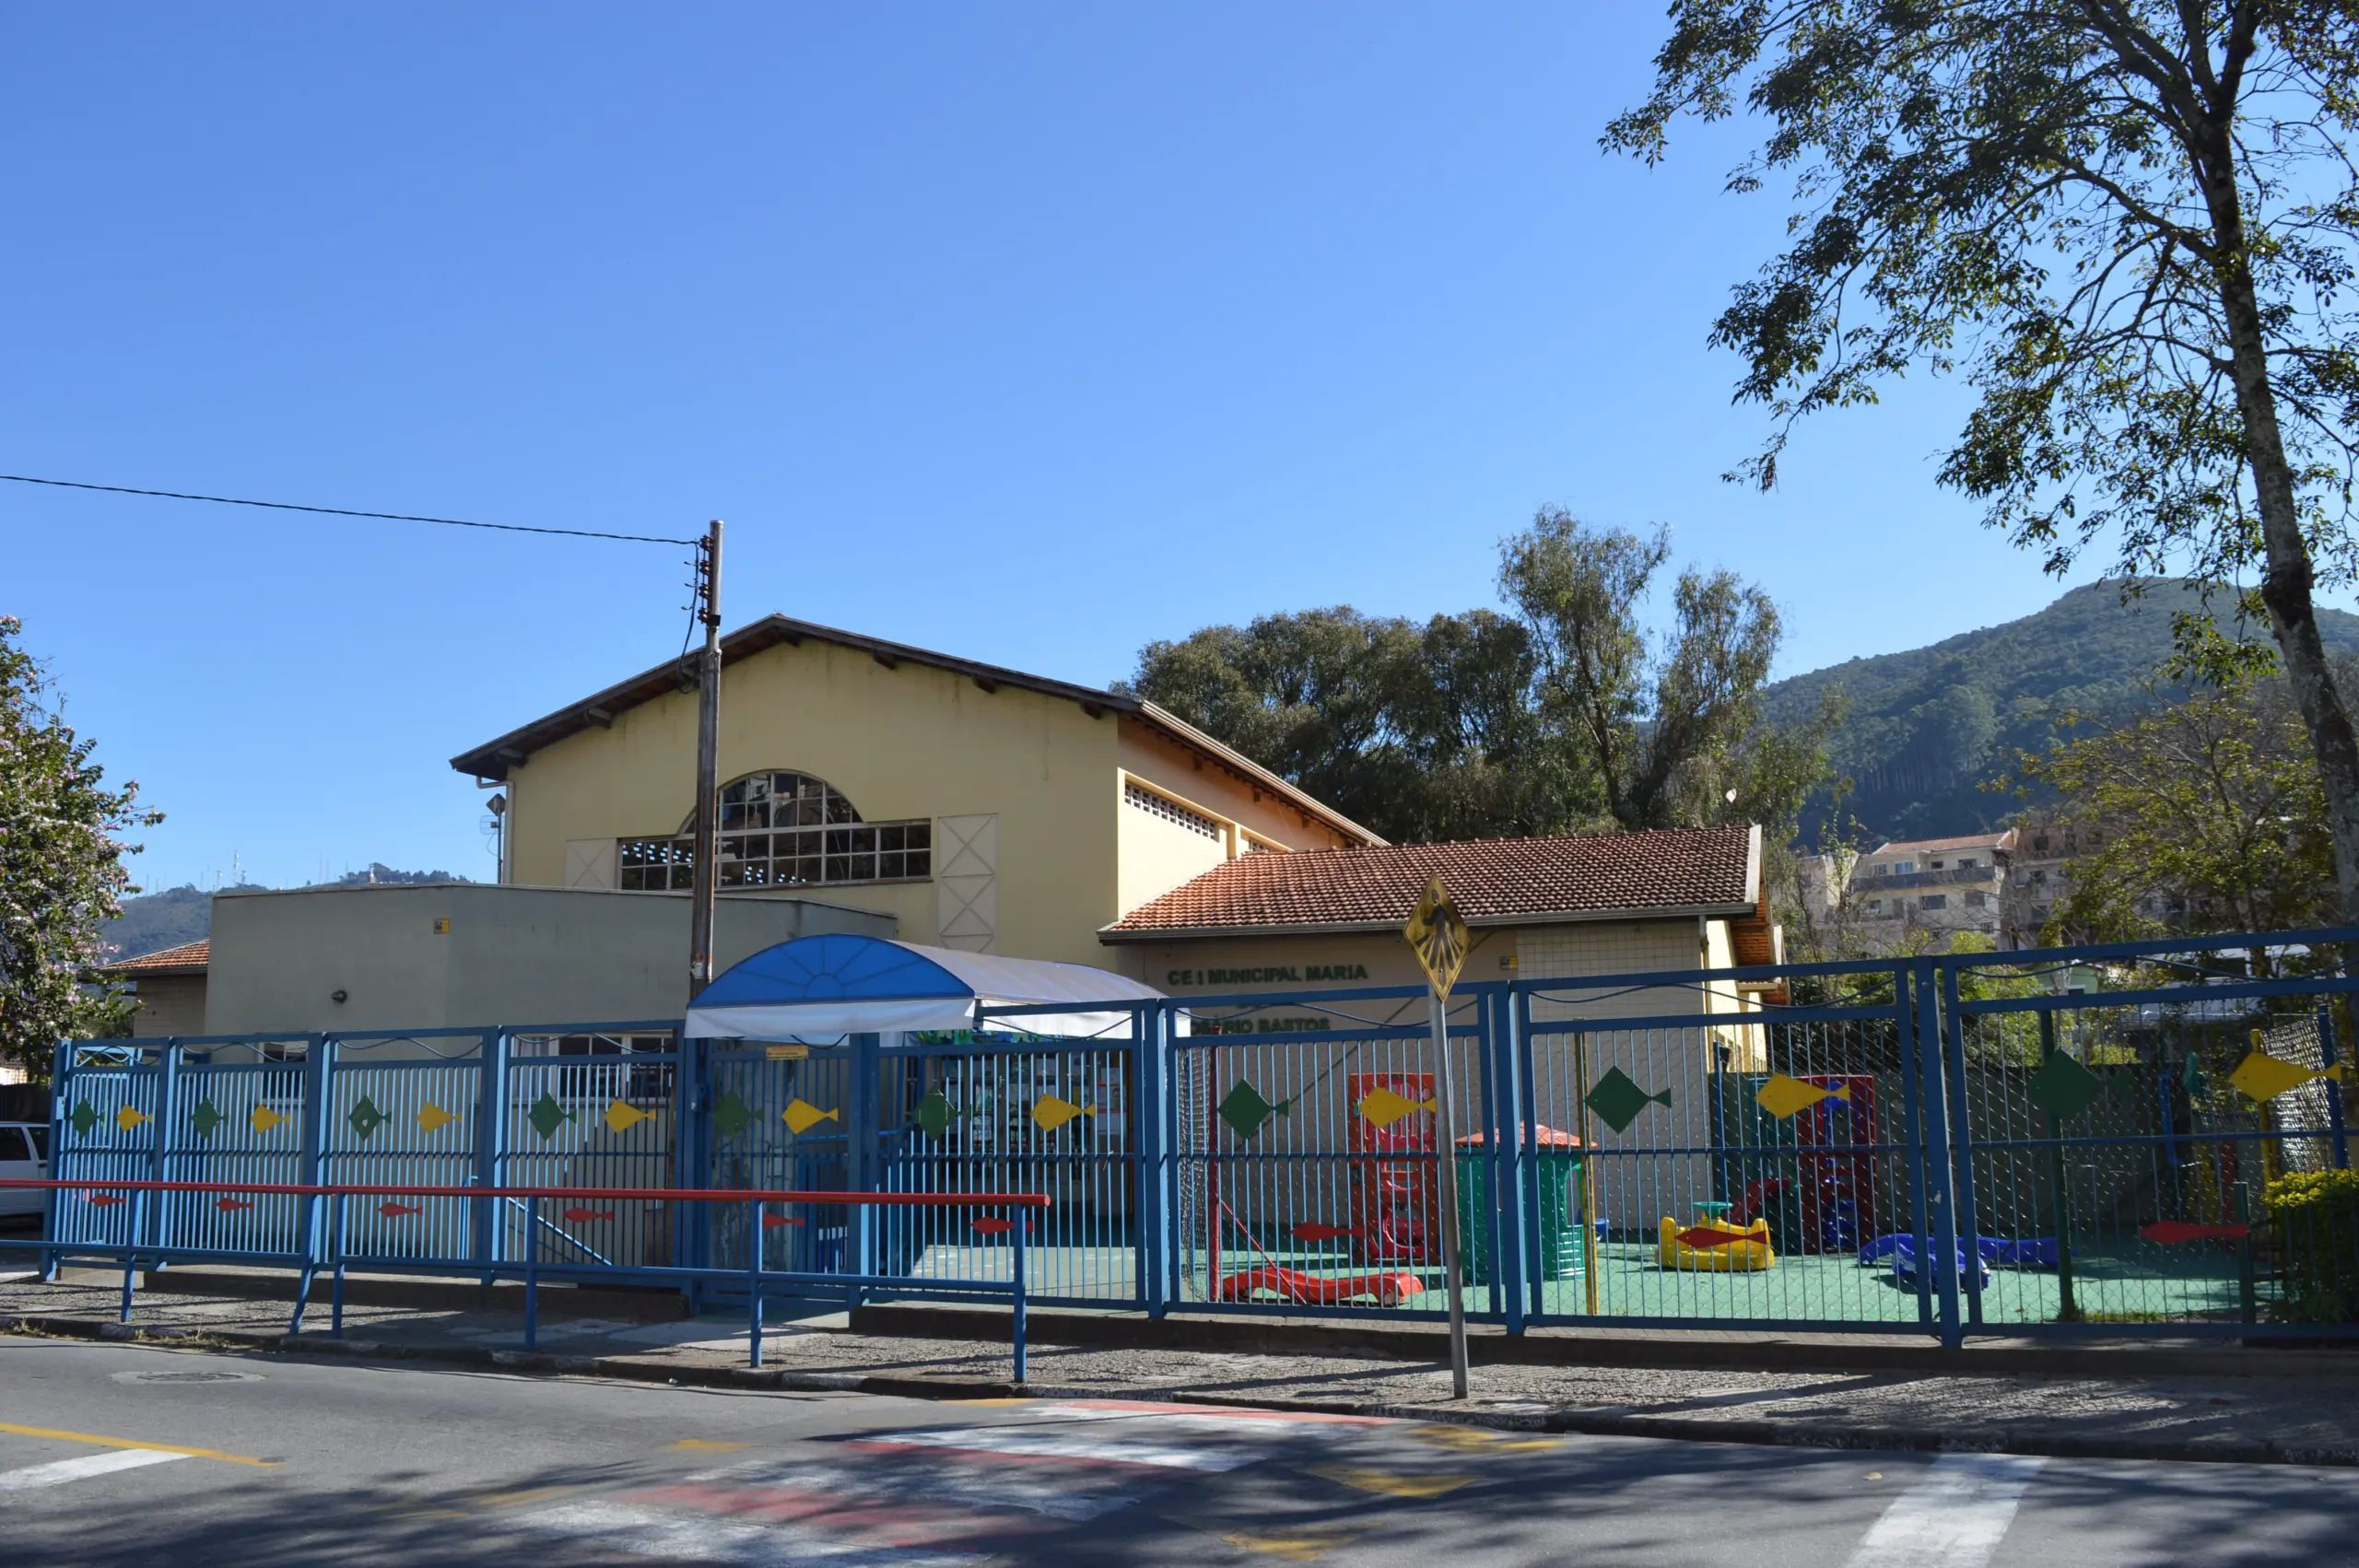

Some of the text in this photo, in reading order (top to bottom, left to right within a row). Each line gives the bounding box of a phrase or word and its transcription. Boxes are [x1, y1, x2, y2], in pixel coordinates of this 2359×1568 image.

[1208, 966, 1301, 984] MUNICIPAL
[1306, 965, 1368, 981] MARIA
[1258, 1017, 1331, 1033] BASTOS
